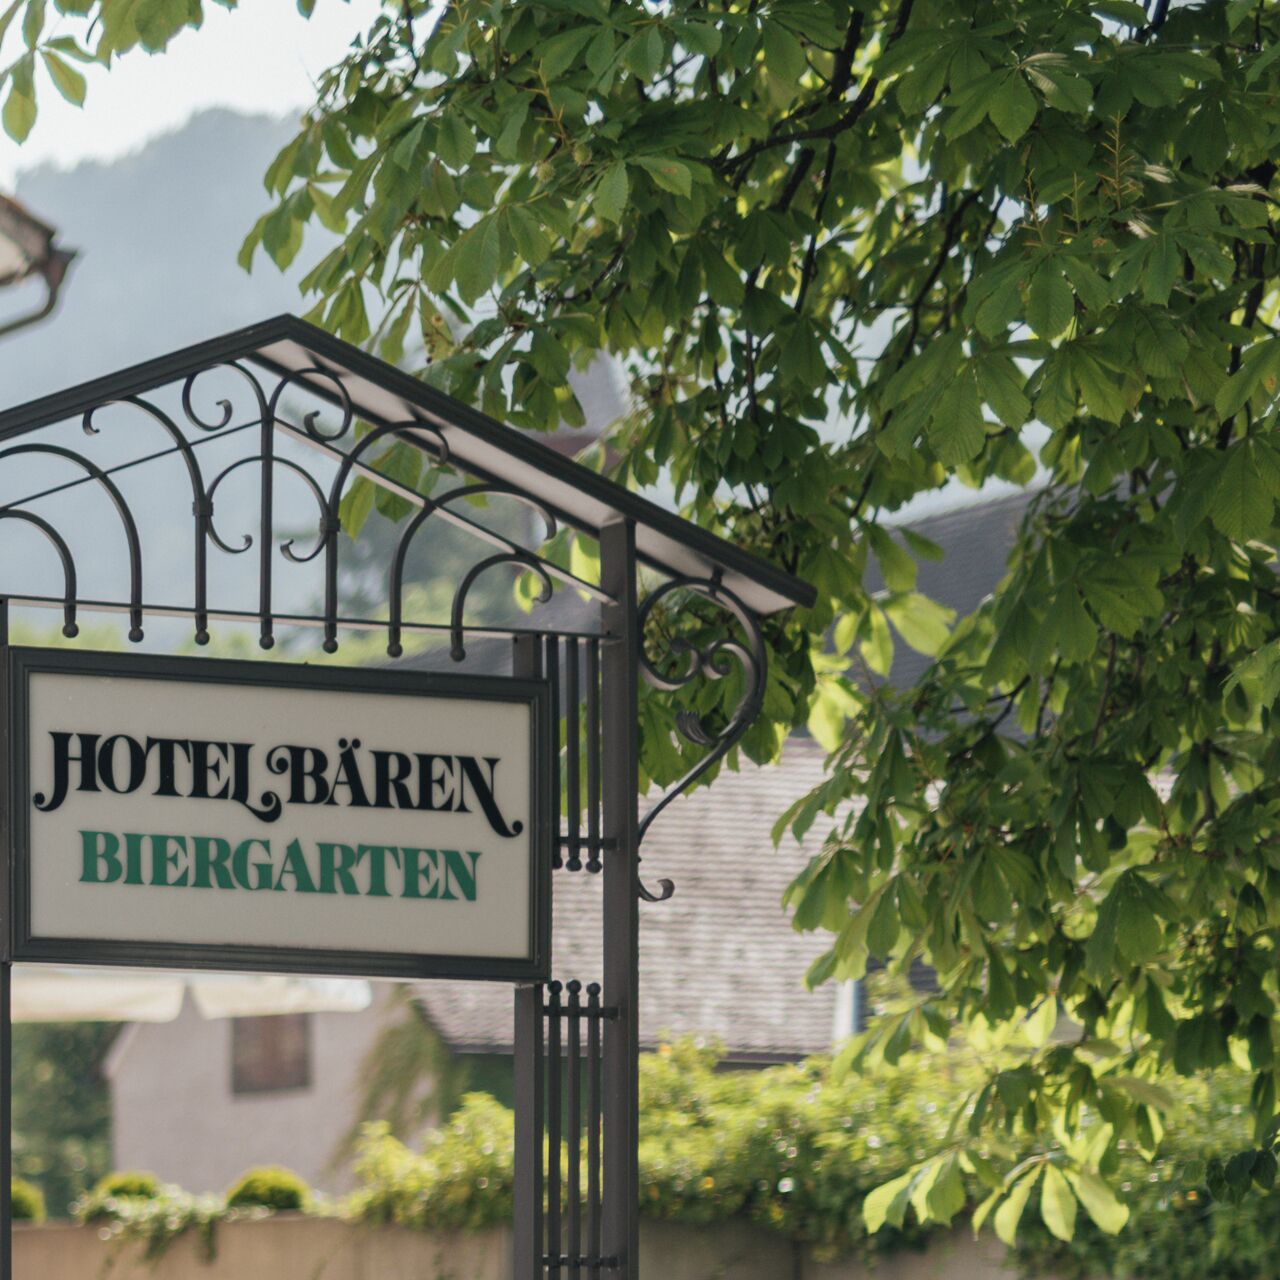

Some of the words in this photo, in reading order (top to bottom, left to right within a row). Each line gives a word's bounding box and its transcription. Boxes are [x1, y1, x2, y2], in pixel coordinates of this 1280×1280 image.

[33, 731, 282, 823] HOTEL
[266, 738, 524, 838] BÄREN
[78, 830, 482, 902] BIERGARTEN
